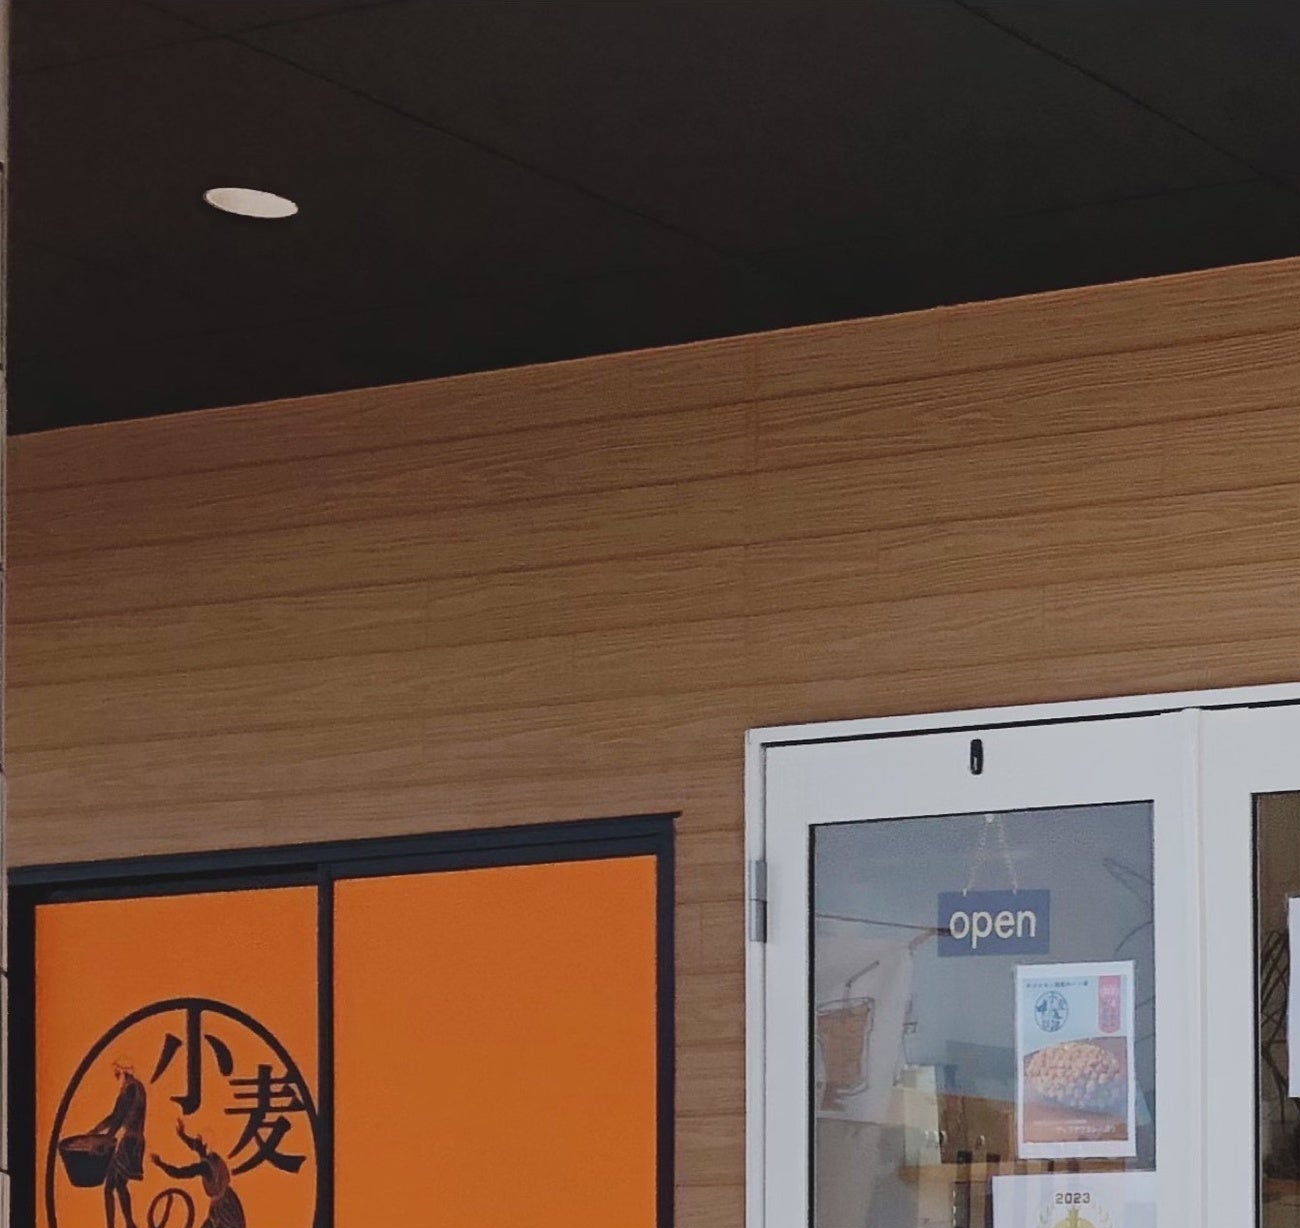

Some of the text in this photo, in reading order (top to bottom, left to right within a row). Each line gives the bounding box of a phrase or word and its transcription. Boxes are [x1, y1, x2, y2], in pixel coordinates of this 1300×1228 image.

[949, 910, 1037, 949] open
[151, 1003, 308, 1175] 小麦
[1055, 1192, 1091, 1205] 2023
